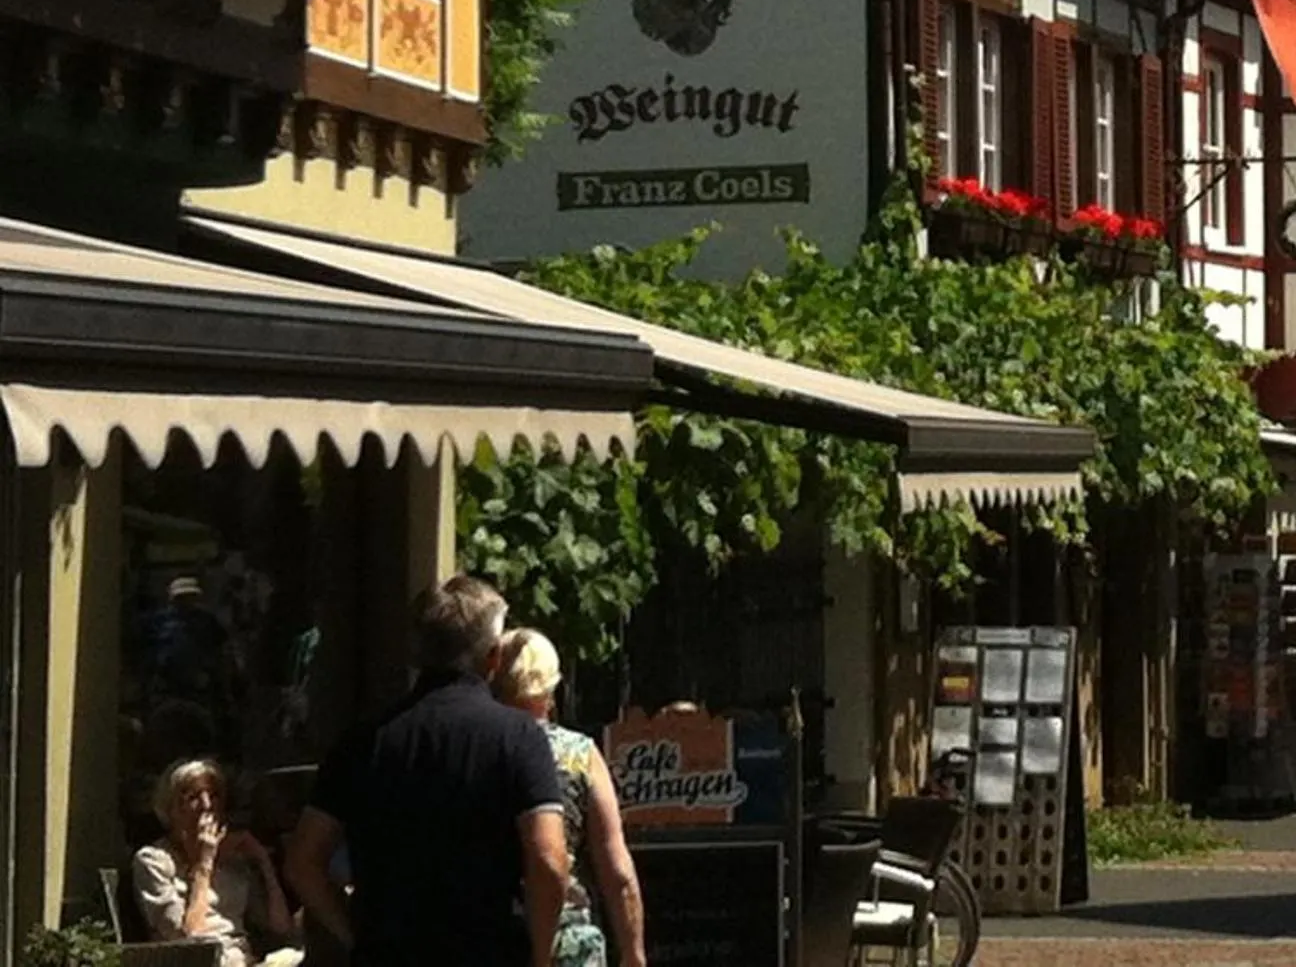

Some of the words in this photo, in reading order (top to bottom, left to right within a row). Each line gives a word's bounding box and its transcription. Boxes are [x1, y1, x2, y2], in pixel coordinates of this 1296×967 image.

[568, 72, 800, 144] Weingut
[573, 176, 687, 206] Franz
[694, 170, 793, 201] Coels
[627, 743, 678, 779] Café
